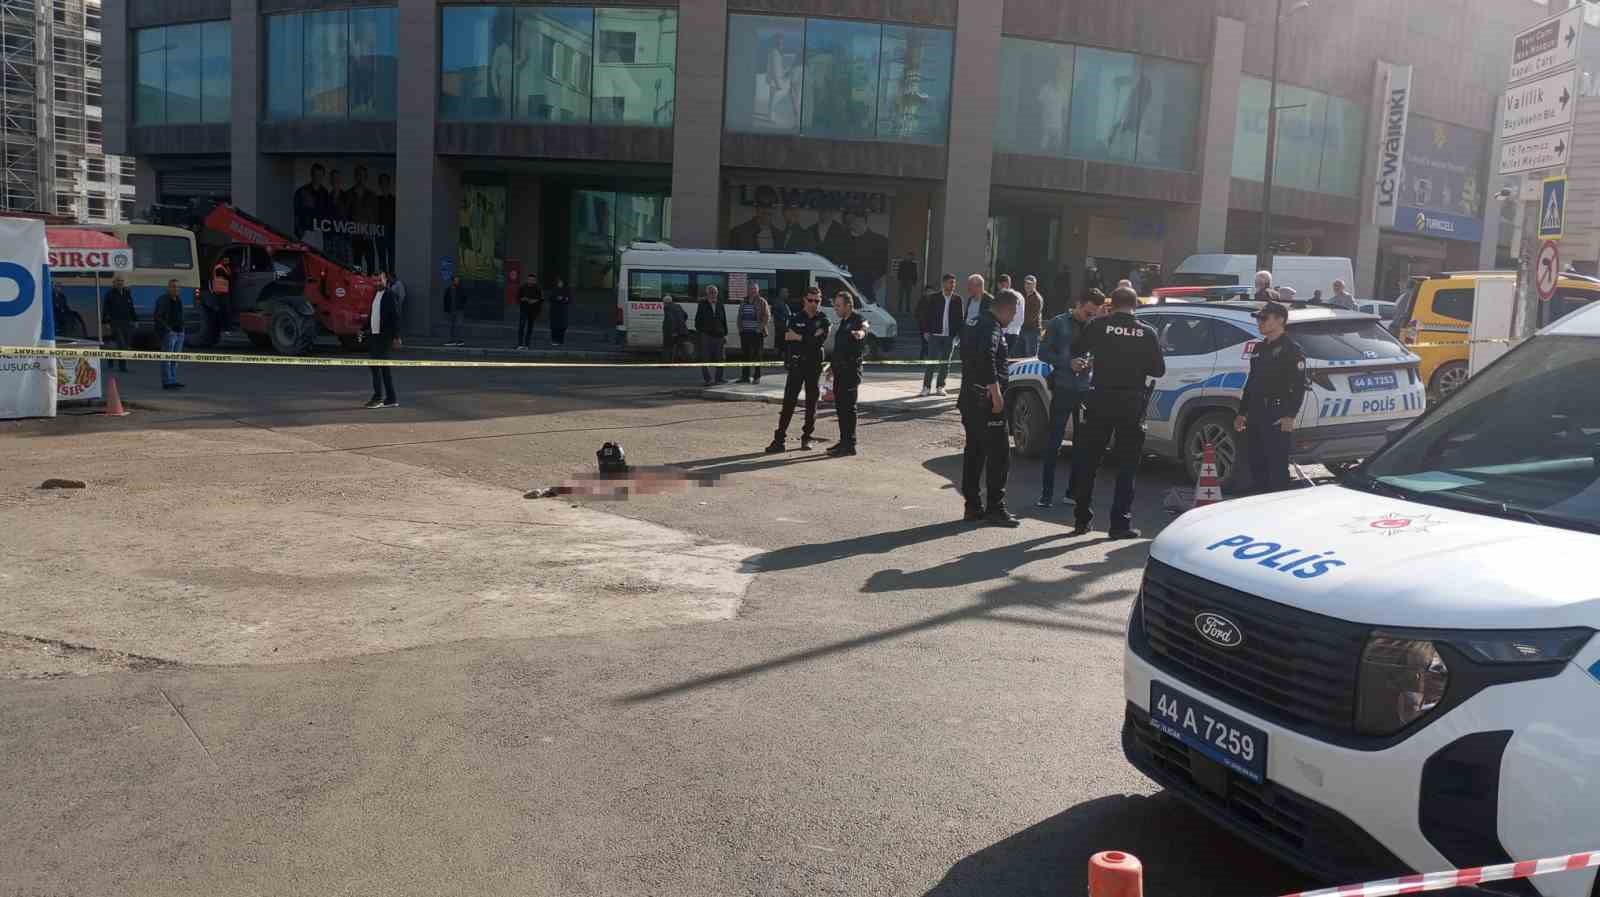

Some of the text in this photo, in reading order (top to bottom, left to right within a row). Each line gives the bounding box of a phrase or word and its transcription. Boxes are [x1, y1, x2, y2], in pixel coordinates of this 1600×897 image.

[1507, 86, 1545, 111] Valilik
[1378, 178, 1395, 207] LC
[1362, 395, 1396, 412] POLİS
[1206, 534, 1347, 579] POLİS
[1202, 616, 1233, 642] Ford
[1157, 693, 1179, 722] 44
[1182, 707, 1198, 735] A
[1203, 715, 1254, 761] 7259
